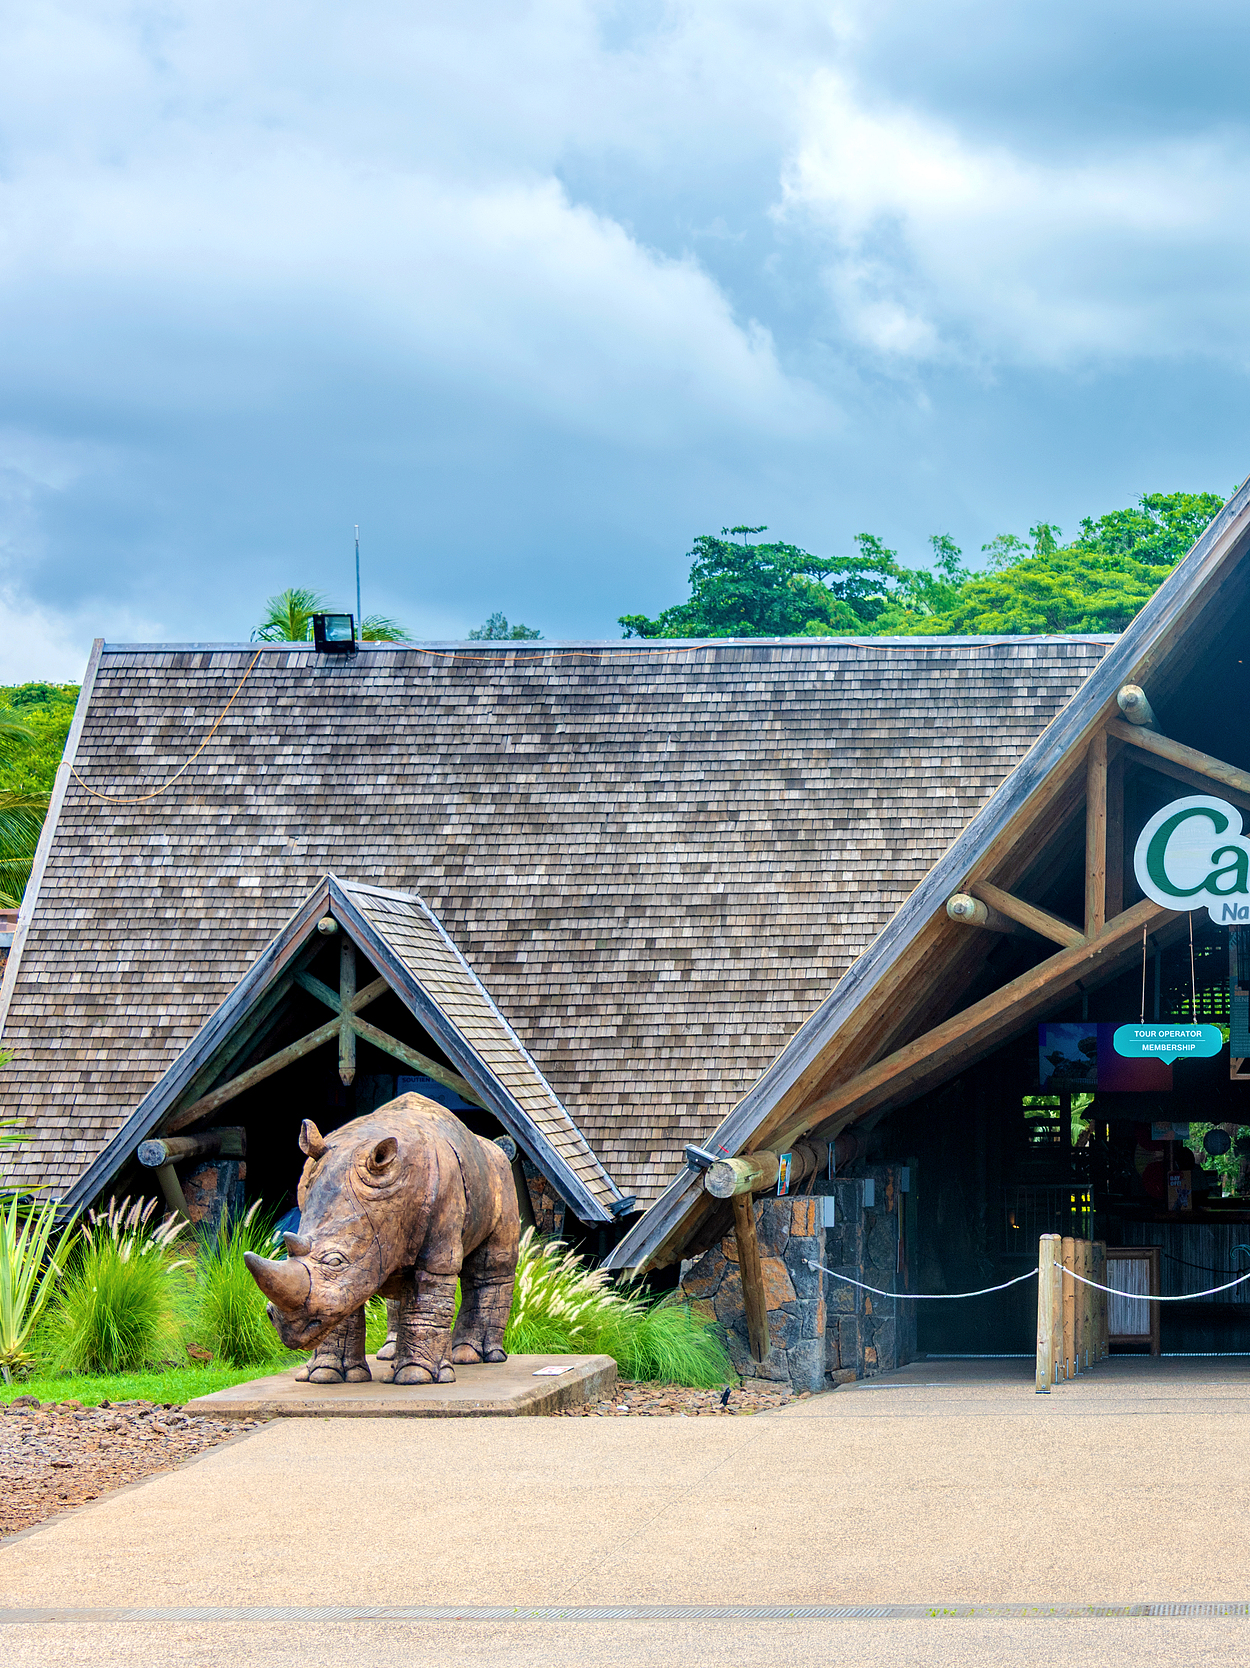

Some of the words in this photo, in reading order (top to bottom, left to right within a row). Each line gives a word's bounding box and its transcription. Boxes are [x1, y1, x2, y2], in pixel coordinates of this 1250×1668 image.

[1134, 1030, 1156, 1038] TOUR
[1158, 1030, 1202, 1038] OPERATOR
[1142, 1043, 1196, 1051] MEMBERSHIP
